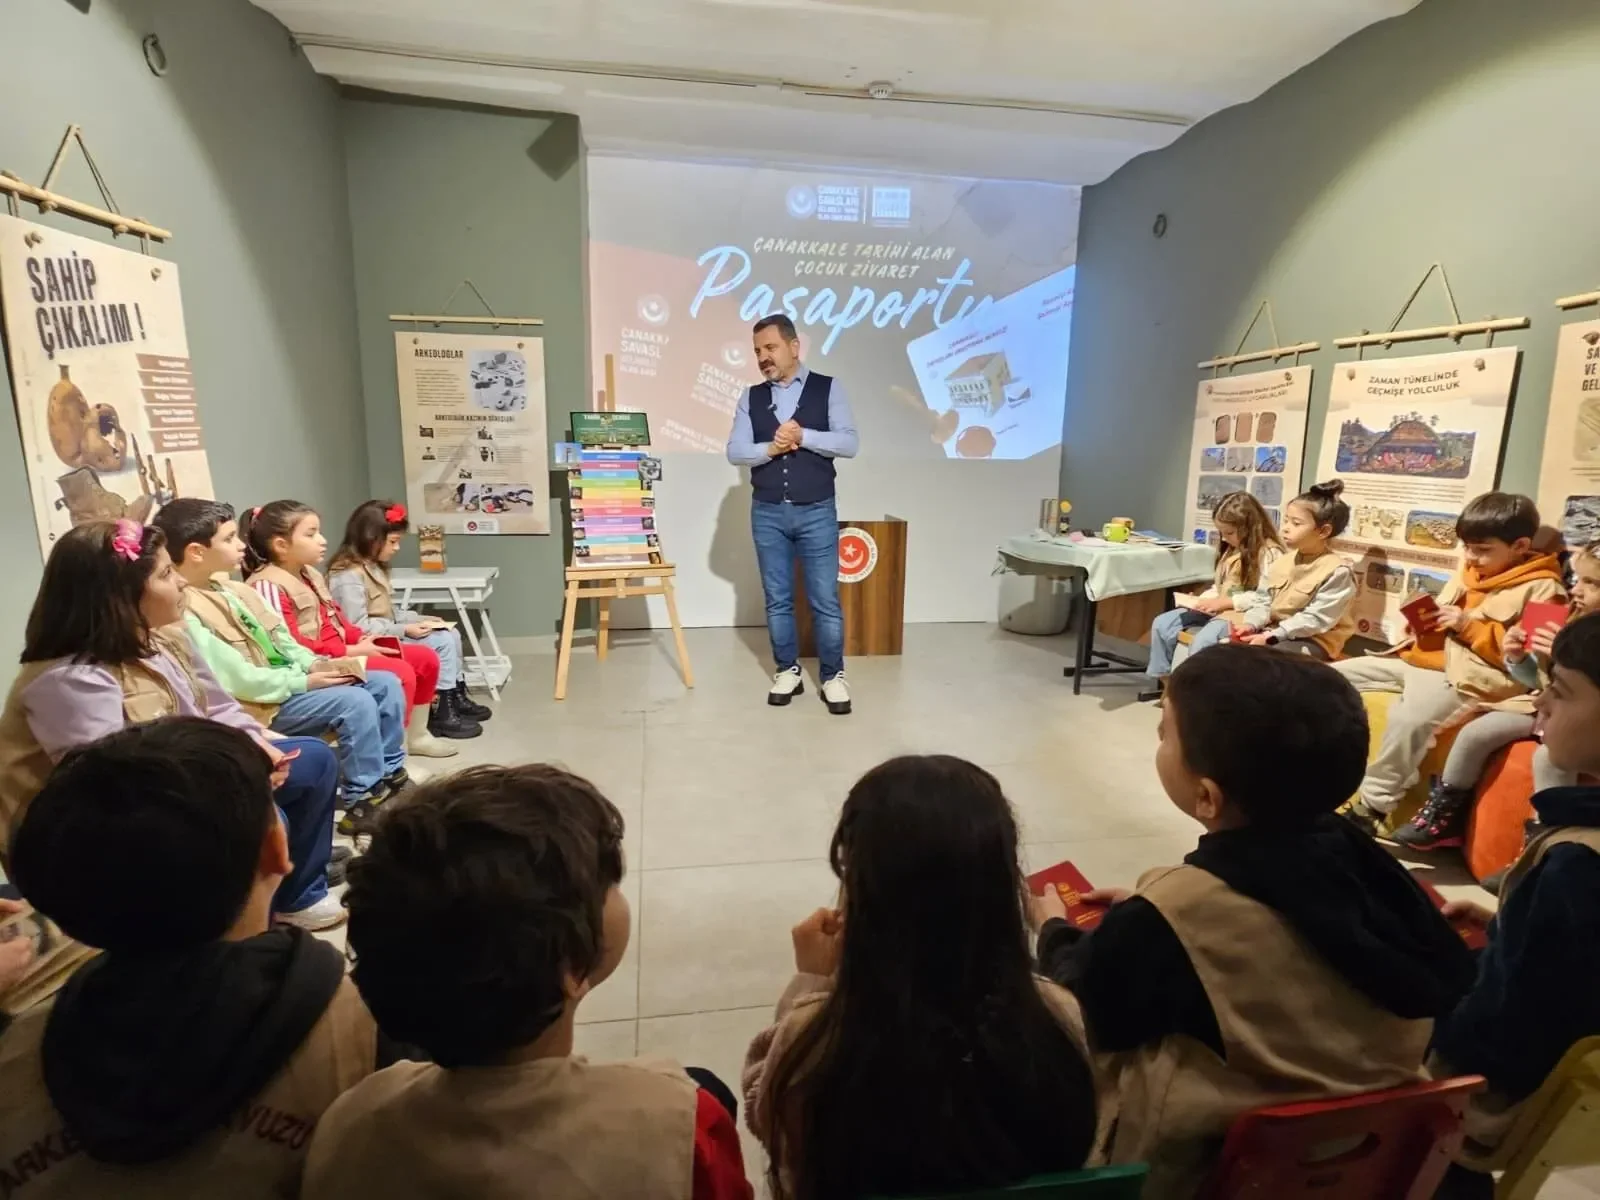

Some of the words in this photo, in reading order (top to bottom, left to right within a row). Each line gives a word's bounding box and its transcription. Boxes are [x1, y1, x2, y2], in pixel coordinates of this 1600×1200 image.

[754, 237, 848, 257] ÇANAKKALE
[853, 241, 910, 260] TARİHİ
[911, 246, 955, 260] ALAN
[26, 250, 97, 304] SAHİP
[794, 260, 844, 277] ÇOCUK
[35, 304, 134, 360] ÇIKALIM
[414, 348, 464, 359] ARKEOLOGLAR
[1368, 375, 1400, 385] ZAMAN
[1403, 369, 1459, 385] TÜNELİNDE
[1584, 363, 1597, 376] VE
[1366, 386, 1404, 397] GEÇMİŞE
[1407, 380, 1460, 396] YOLCULUK
